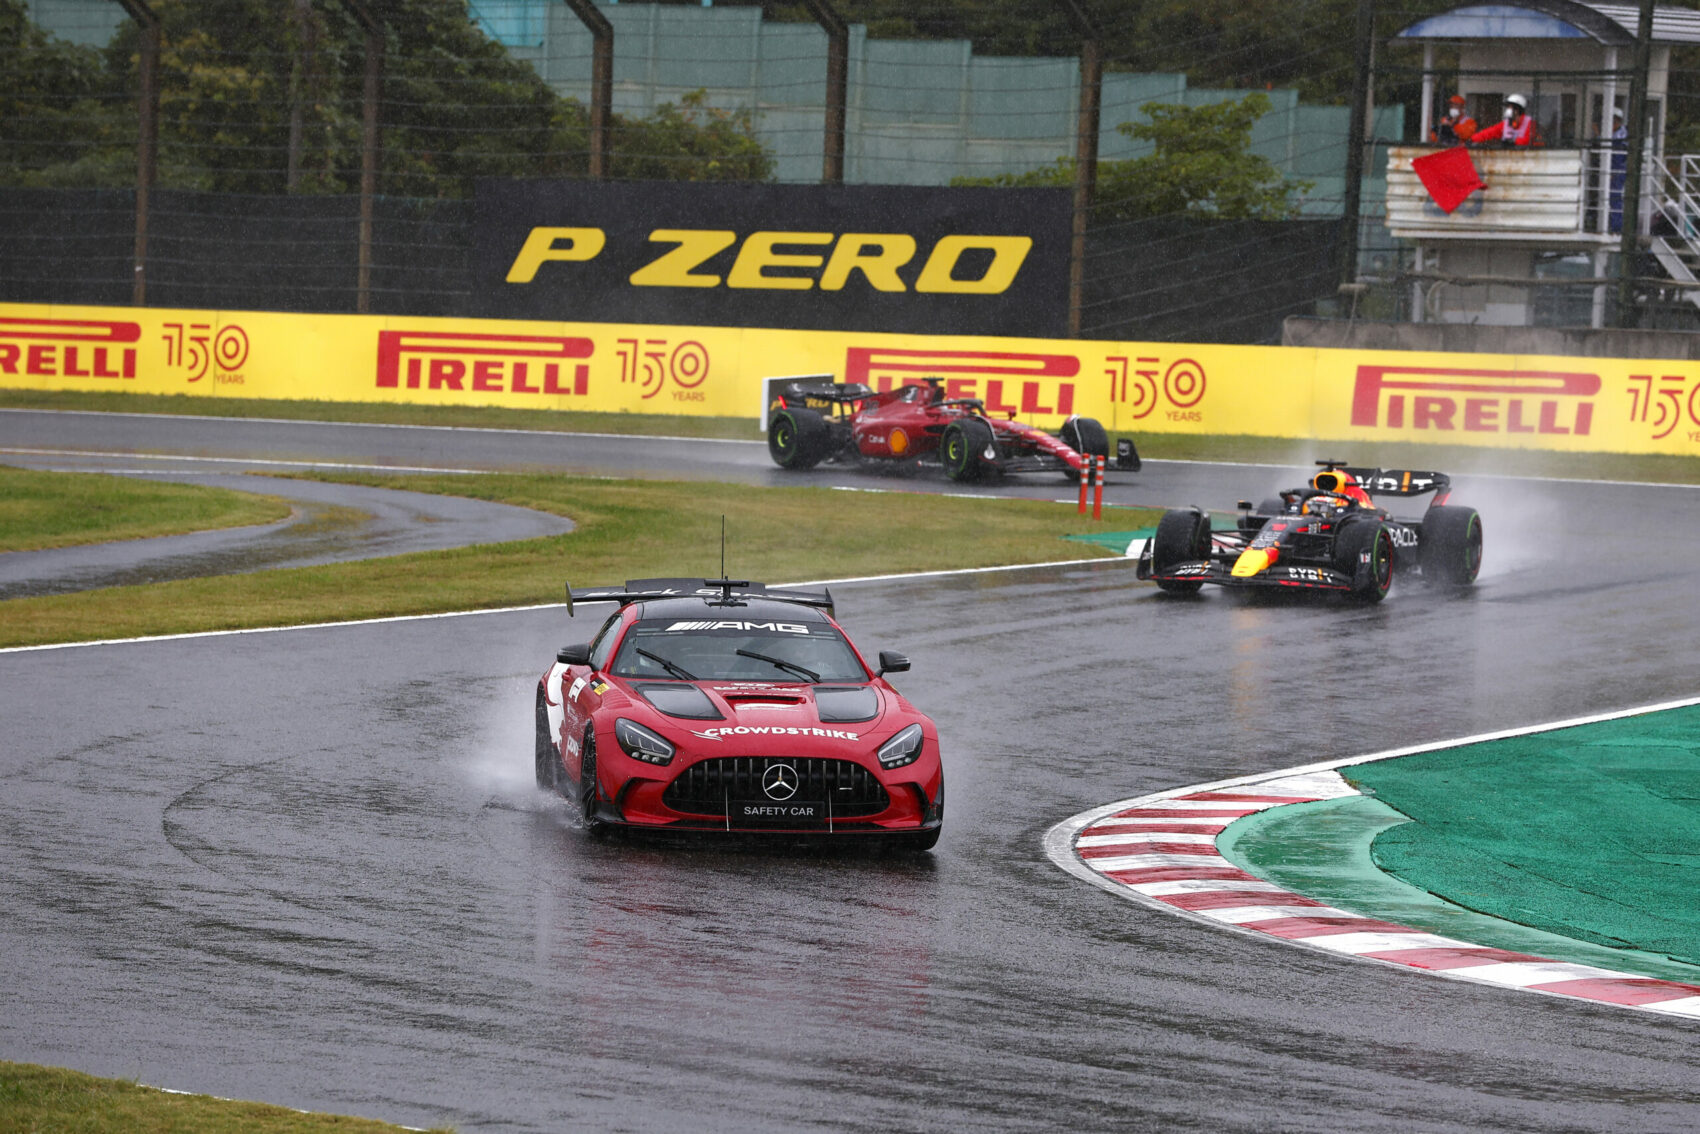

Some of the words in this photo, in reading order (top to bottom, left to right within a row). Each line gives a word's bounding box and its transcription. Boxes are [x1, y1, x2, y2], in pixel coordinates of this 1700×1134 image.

[506, 227, 606, 283] P
[629, 229, 1033, 294] ZERO
[162, 323, 250, 383] 150
[376, 330, 595, 396] PIRELLI
[616, 338, 710, 400] 150
[216, 374, 245, 385] YEARS
[672, 391, 706, 402] YEARS
[1104, 356, 1207, 420] 150
[1165, 410, 1203, 422] YEARS
[1351, 364, 1602, 436] PIRELLI
[711, 621, 810, 634] AMG
[704, 725, 860, 741] CROWDSTRIKE
[743, 806, 787, 816] SAFETY
[790, 807, 814, 816] CAR
